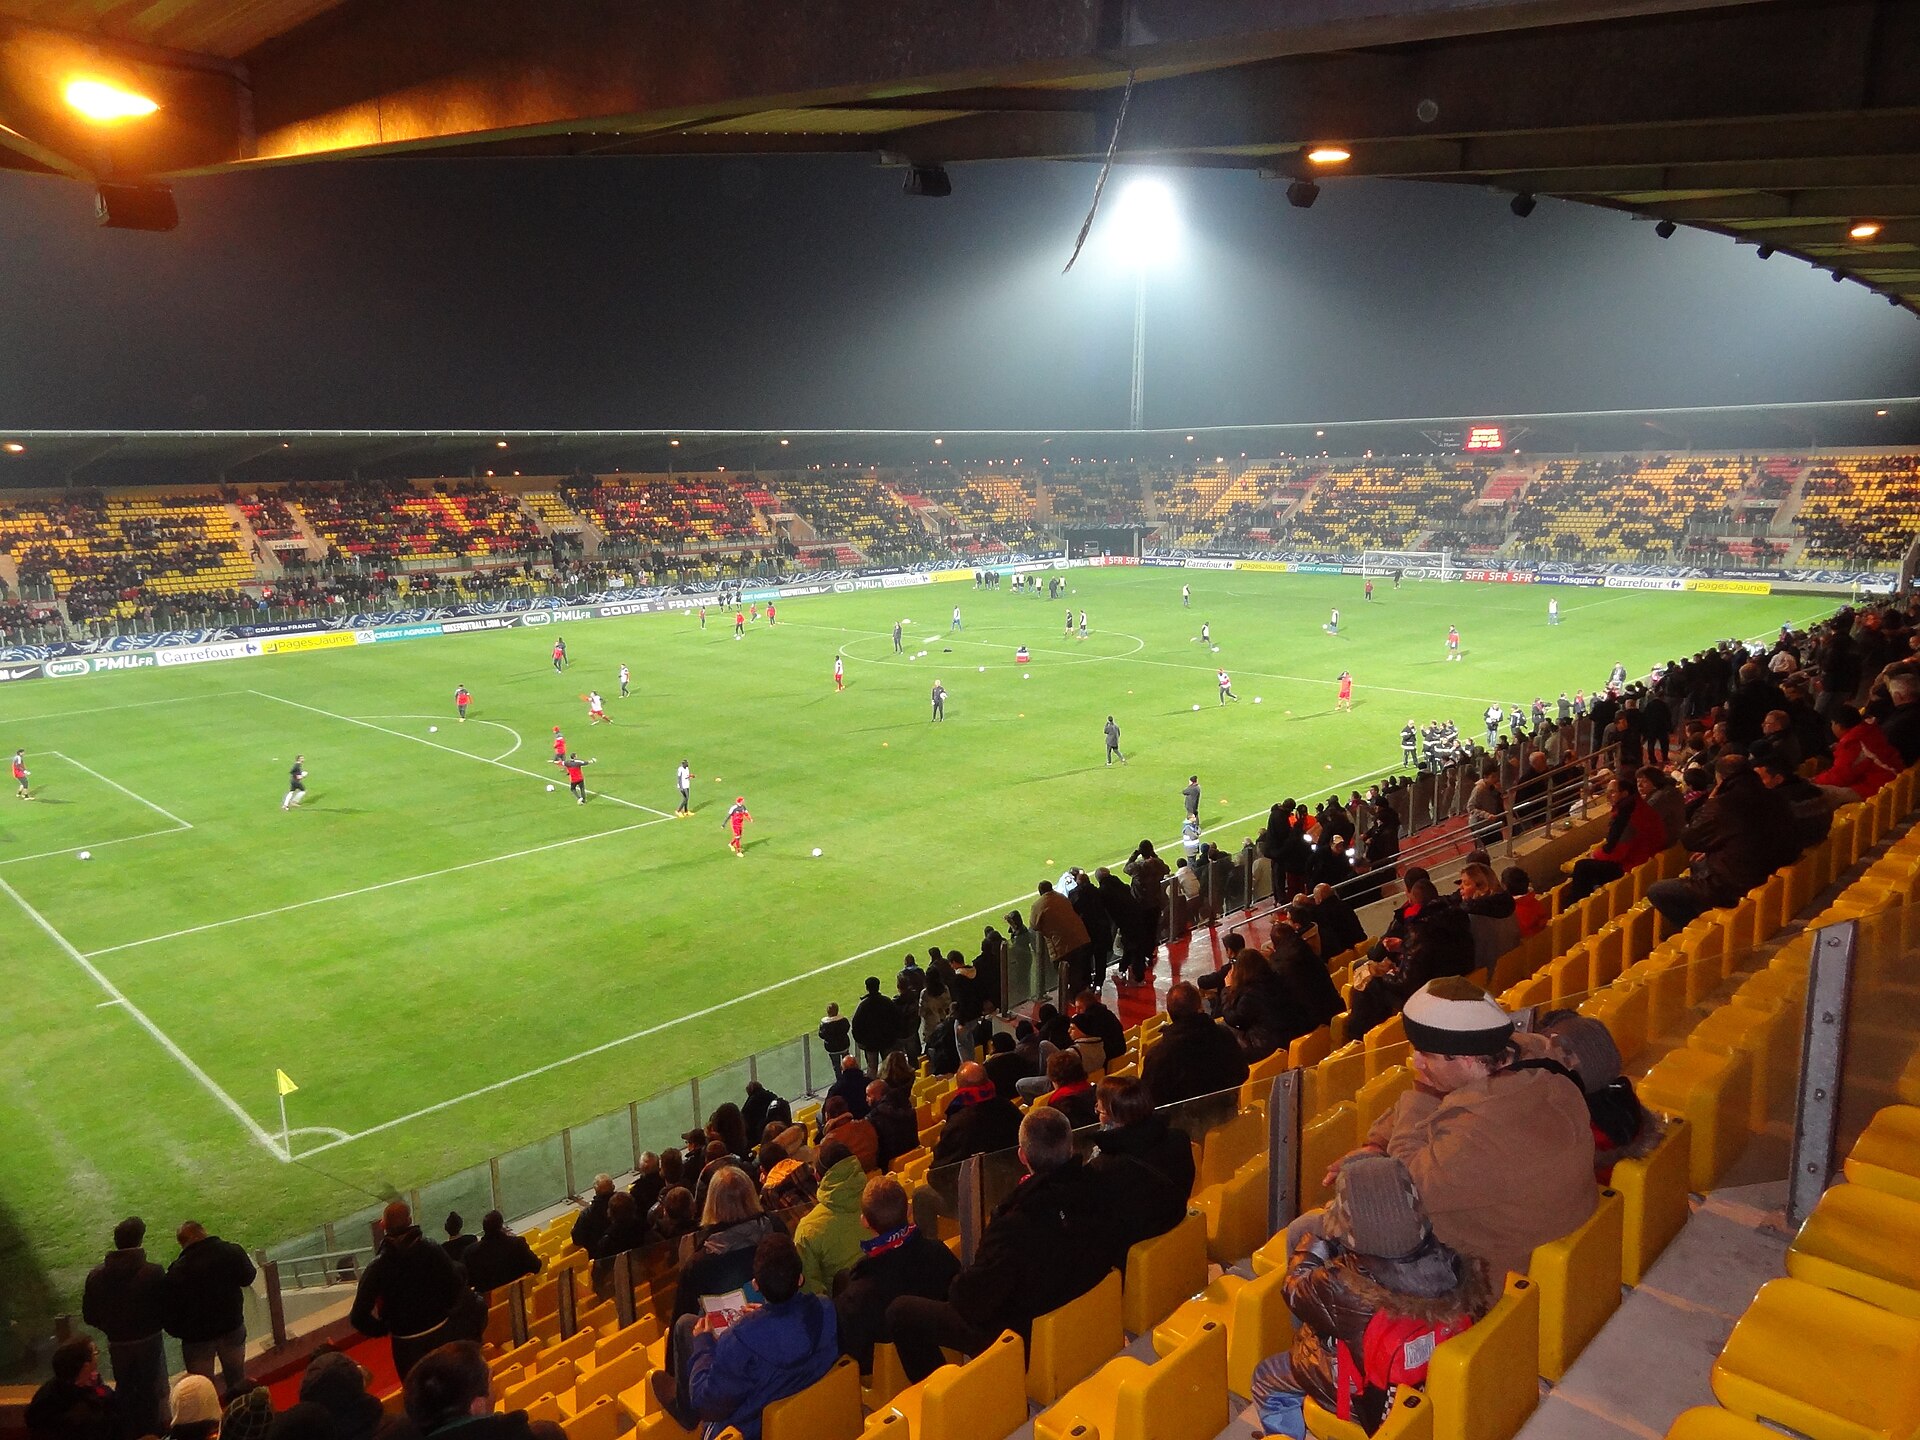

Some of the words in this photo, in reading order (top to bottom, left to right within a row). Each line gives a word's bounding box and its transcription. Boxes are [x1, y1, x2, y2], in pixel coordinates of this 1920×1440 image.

[1109, 556, 1123, 565] SFR
[1126, 557, 1140, 565] SFR
[1156, 559, 1180, 567] Pasquier
[1187, 560, 1221, 569] Carrefour
[1465, 571, 1484, 580] SFR
[1488, 572, 1508, 581] SFR
[1512, 573, 1532, 582] SFR
[1559, 574, 1597, 585] Pasquier
[884, 576, 918, 586] Carrefour
[1608, 577, 1663, 589] Carrefour
[600, 603, 650, 617] COUPE
[668, 596, 719, 610] FRANCE
[255, 626, 280, 634] COUPE
[288, 622, 317, 631] FRANCE
[403, 626, 442, 636] AGRICOLE
[162, 647, 236, 664] Carrefour
